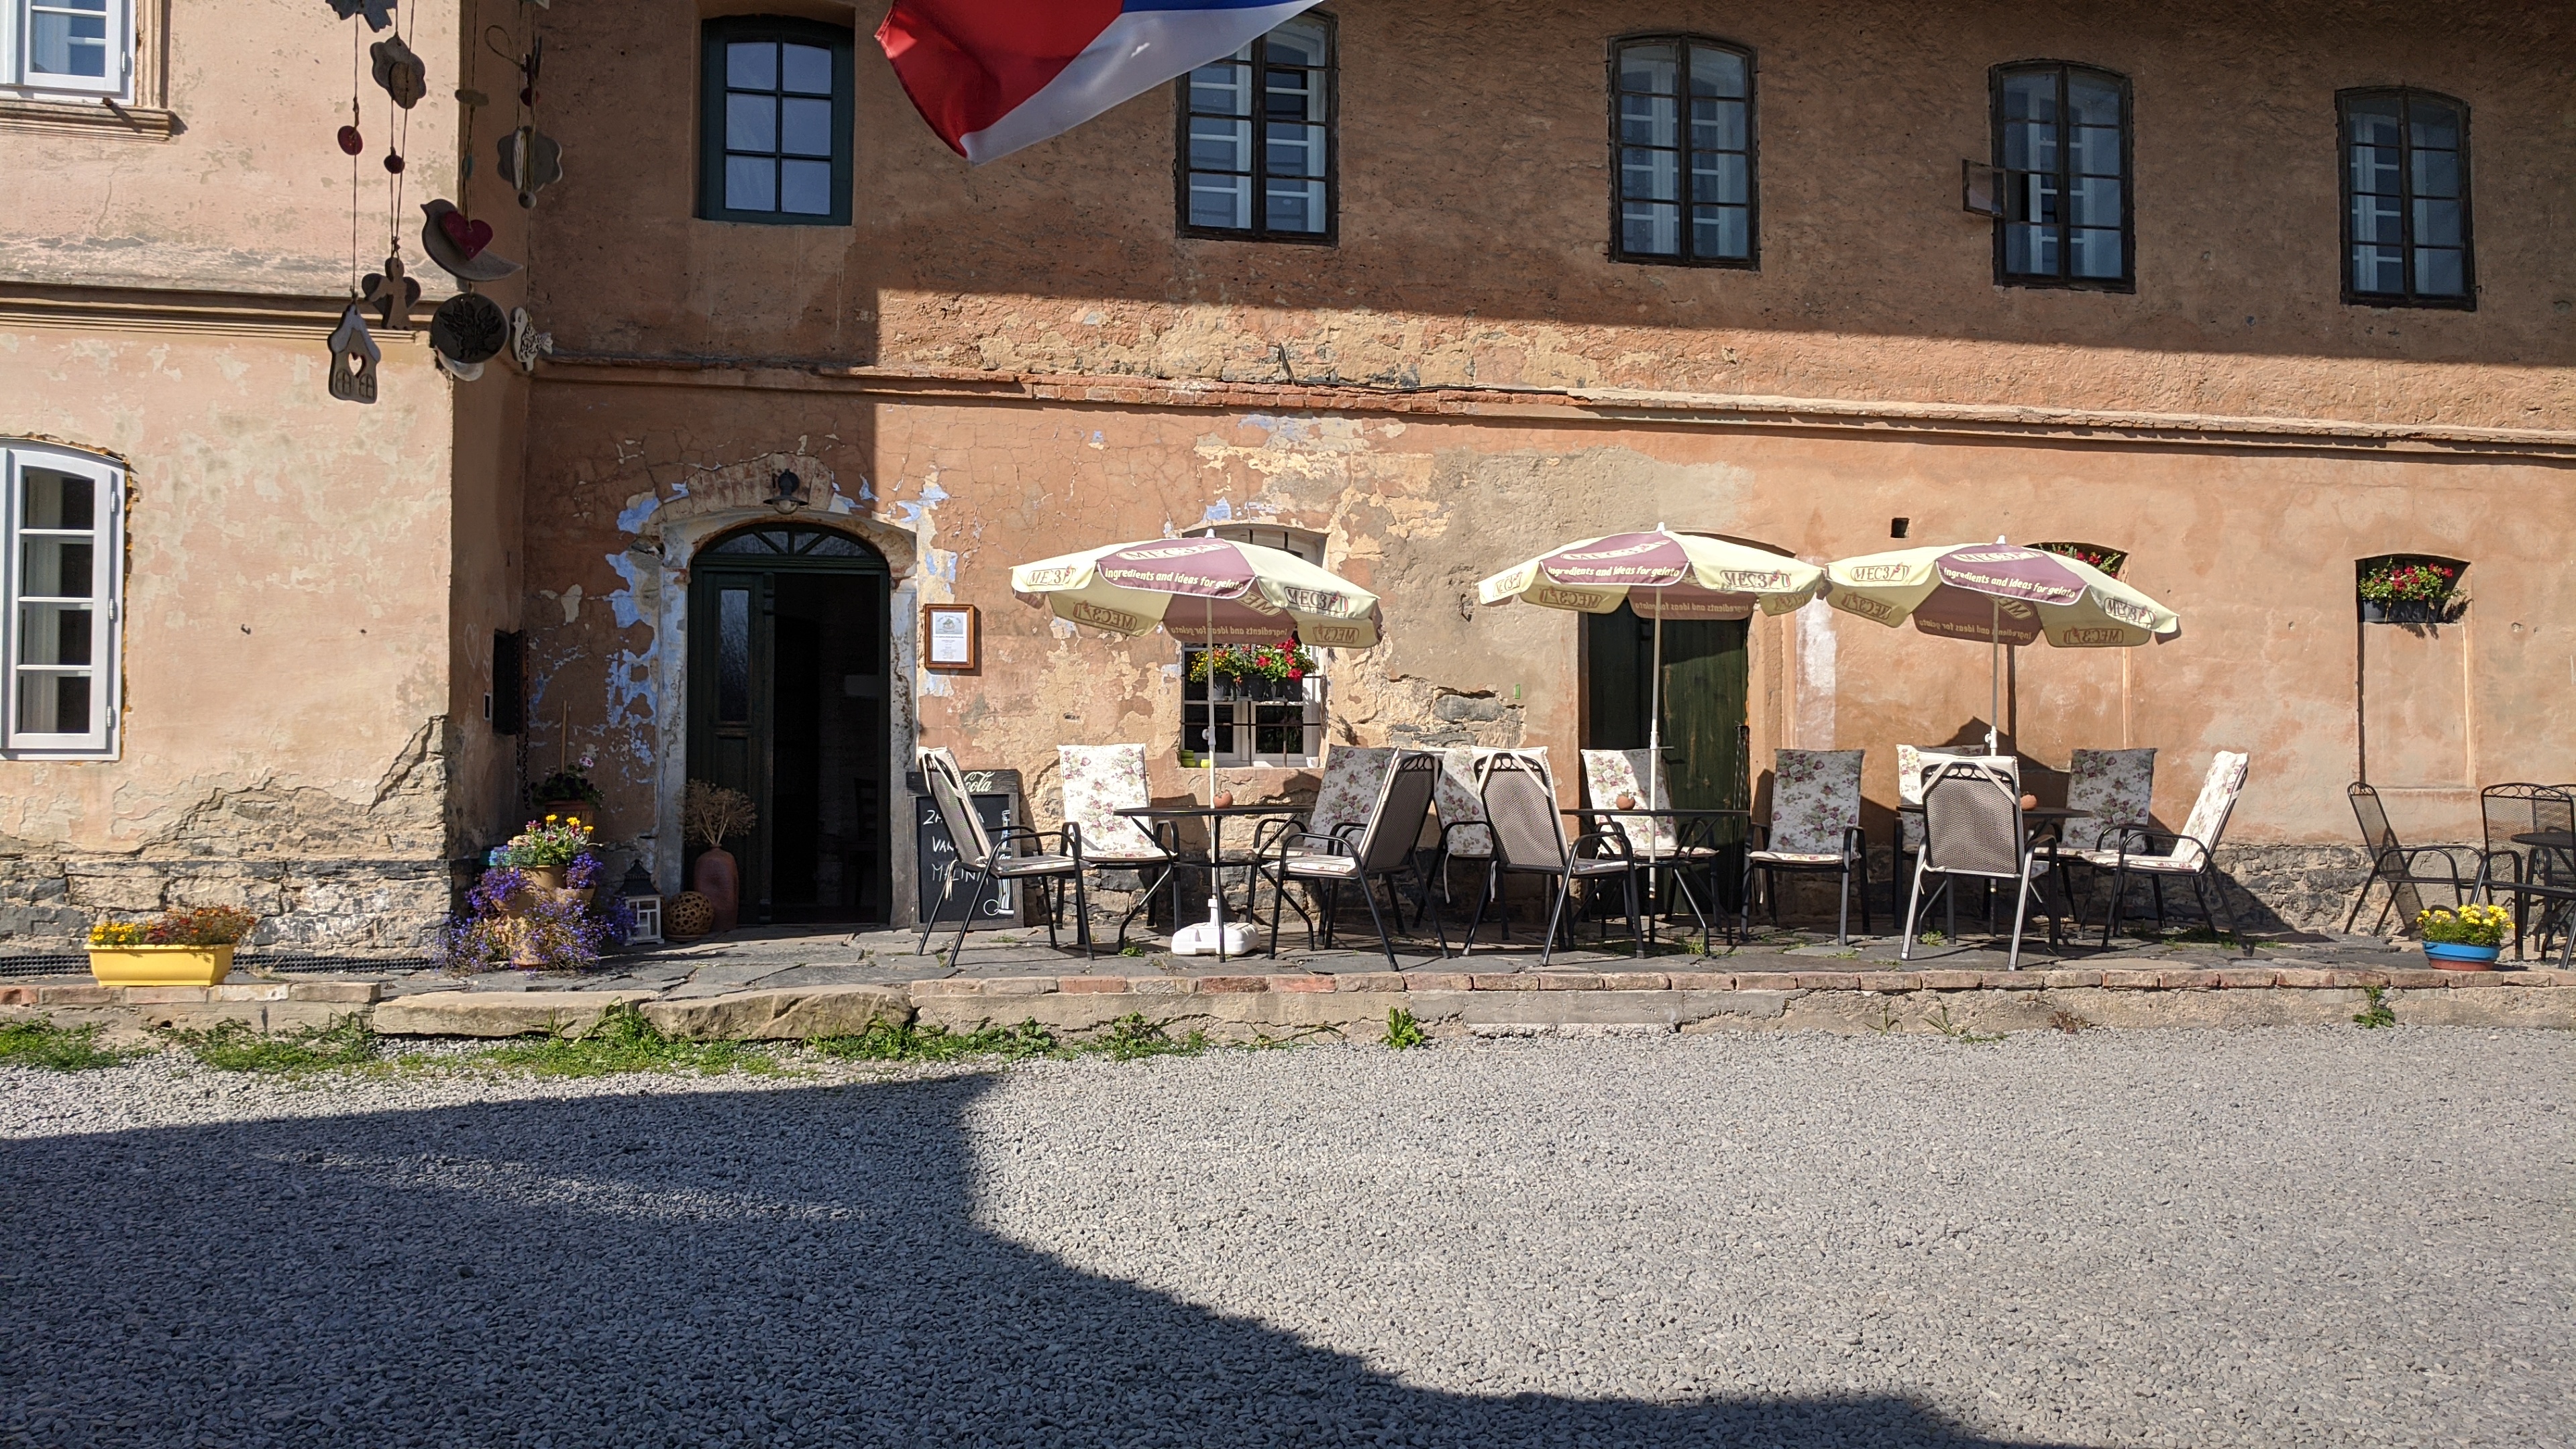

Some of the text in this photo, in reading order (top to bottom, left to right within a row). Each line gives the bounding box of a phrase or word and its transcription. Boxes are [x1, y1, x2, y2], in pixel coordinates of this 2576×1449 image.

[1105, 568, 1244, 590] ingredients and ideas for gelato
[1548, 566, 1680, 578] ingredients and ideas for gelato
[1724, 572, 1768, 588] MEC3
[1854, 566, 1890, 580] MEC3
[1943, 567, 2076, 598] ingredients and ideas for gelato
[1287, 589, 1328, 609] MEC3
